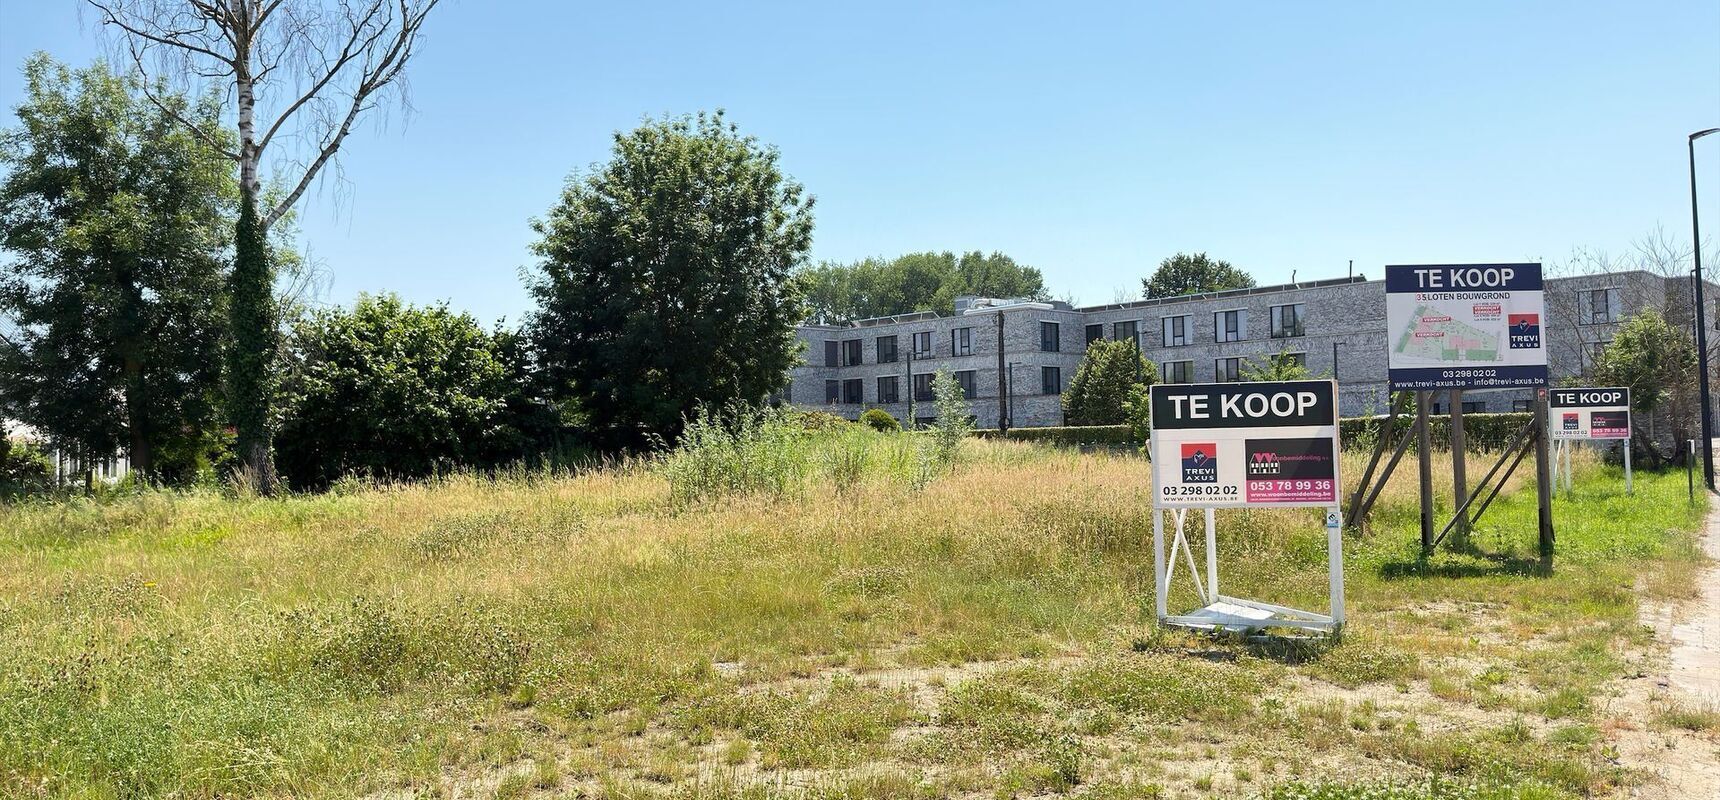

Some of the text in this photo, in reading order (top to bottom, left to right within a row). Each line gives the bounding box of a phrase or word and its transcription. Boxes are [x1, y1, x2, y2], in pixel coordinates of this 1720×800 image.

[1414, 268, 1514, 288] TE KOOP
[1394, 380, 1466, 388] www.trevi-axus.be
[1474, 378, 1544, 386] info@trevi-axus.be
[1557, 392, 1622, 404] TE KOOP
[1168, 392, 1318, 419] TE KOOP
[1163, 486, 1238, 495] 03 298 02 02
[1250, 481, 1330, 490] 053 78 99 36
